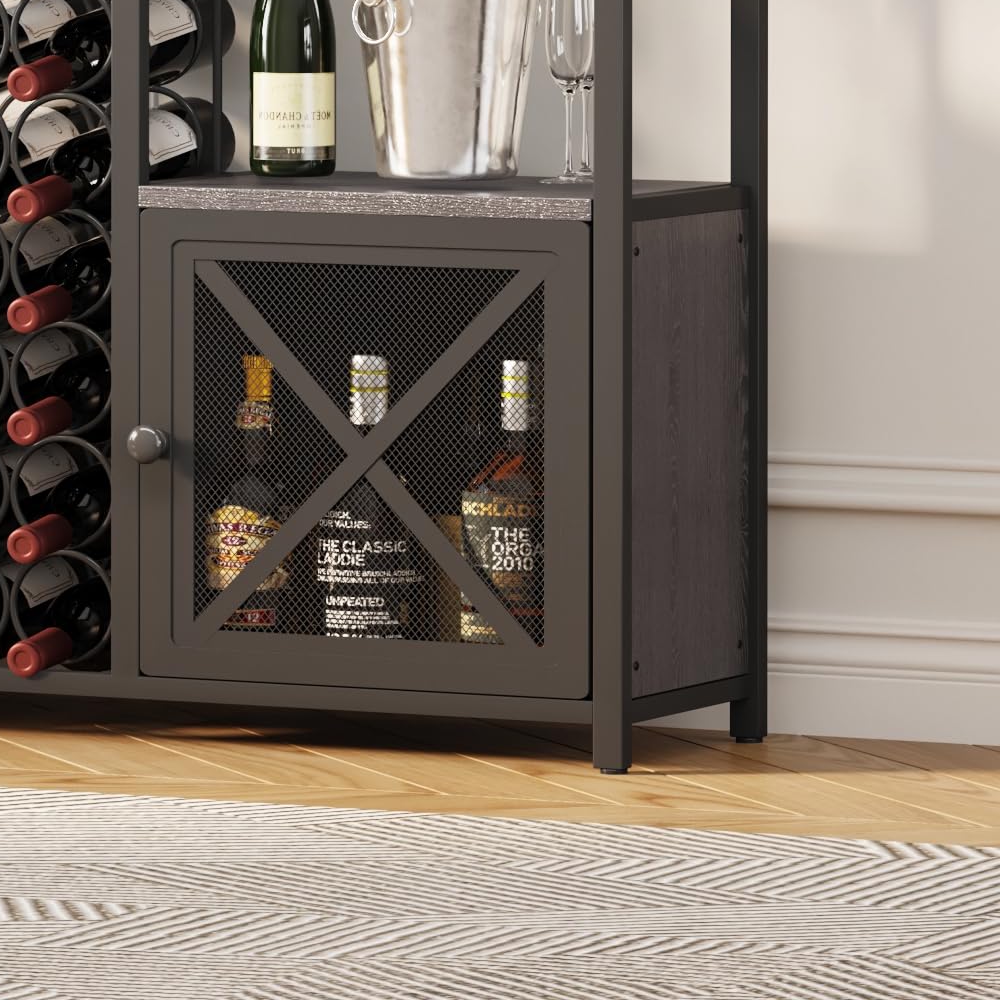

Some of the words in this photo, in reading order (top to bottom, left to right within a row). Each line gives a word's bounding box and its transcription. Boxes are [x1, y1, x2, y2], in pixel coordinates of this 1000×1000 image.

[490, 526, 530, 542] THE
[318, 539, 340, 552] THE
[342, 540, 407, 553] CLASSIC
[317, 552, 366, 567] LADDIE
[491, 556, 534, 571] 2010
[325, 595, 385, 607] UNPEATED
